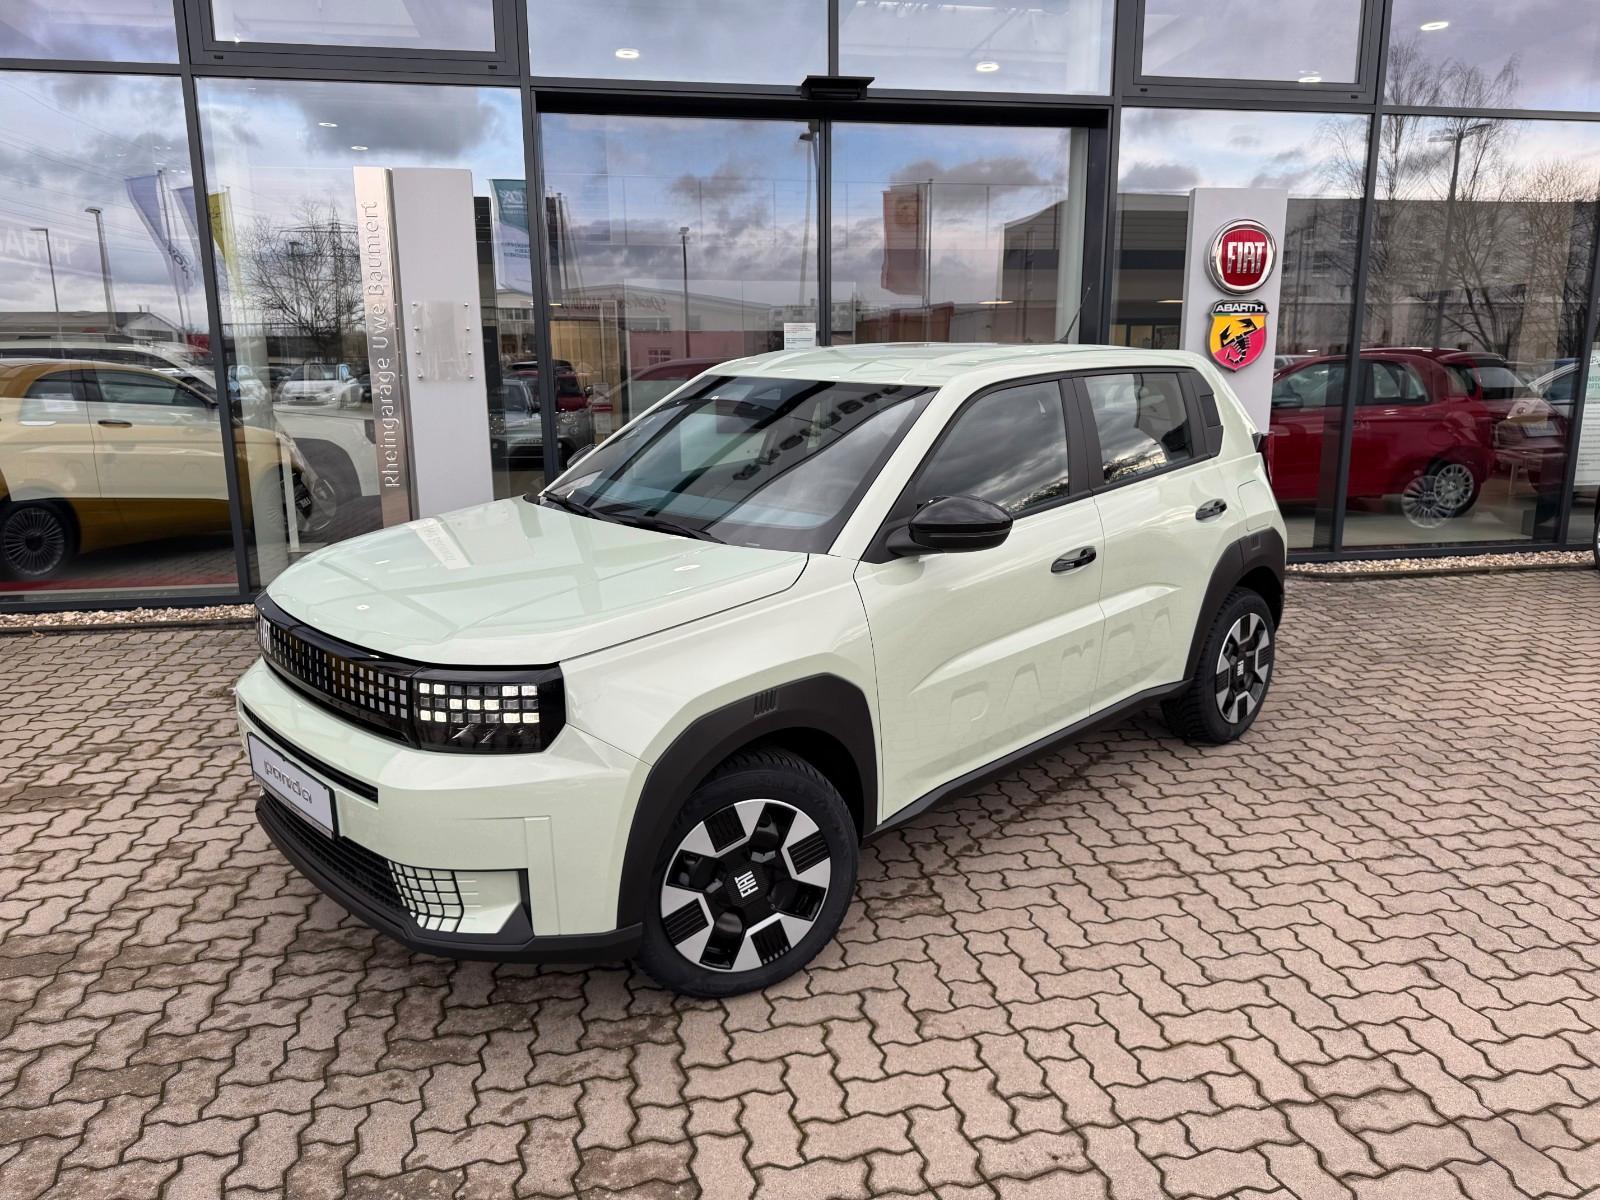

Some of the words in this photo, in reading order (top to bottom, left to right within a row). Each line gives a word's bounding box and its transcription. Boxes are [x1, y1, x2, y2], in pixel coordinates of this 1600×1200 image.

[0, 226, 71, 265] ARTH
[361, 200, 384, 296] Baumert
[1226, 241, 1266, 274] FIAT
[372, 303, 389, 349] Uwe
[1216, 303, 1264, 312] ABARTH
[377, 357, 401, 488] Rheingarage
[264, 760, 312, 804] panda
[734, 870, 759, 898] FIAT
